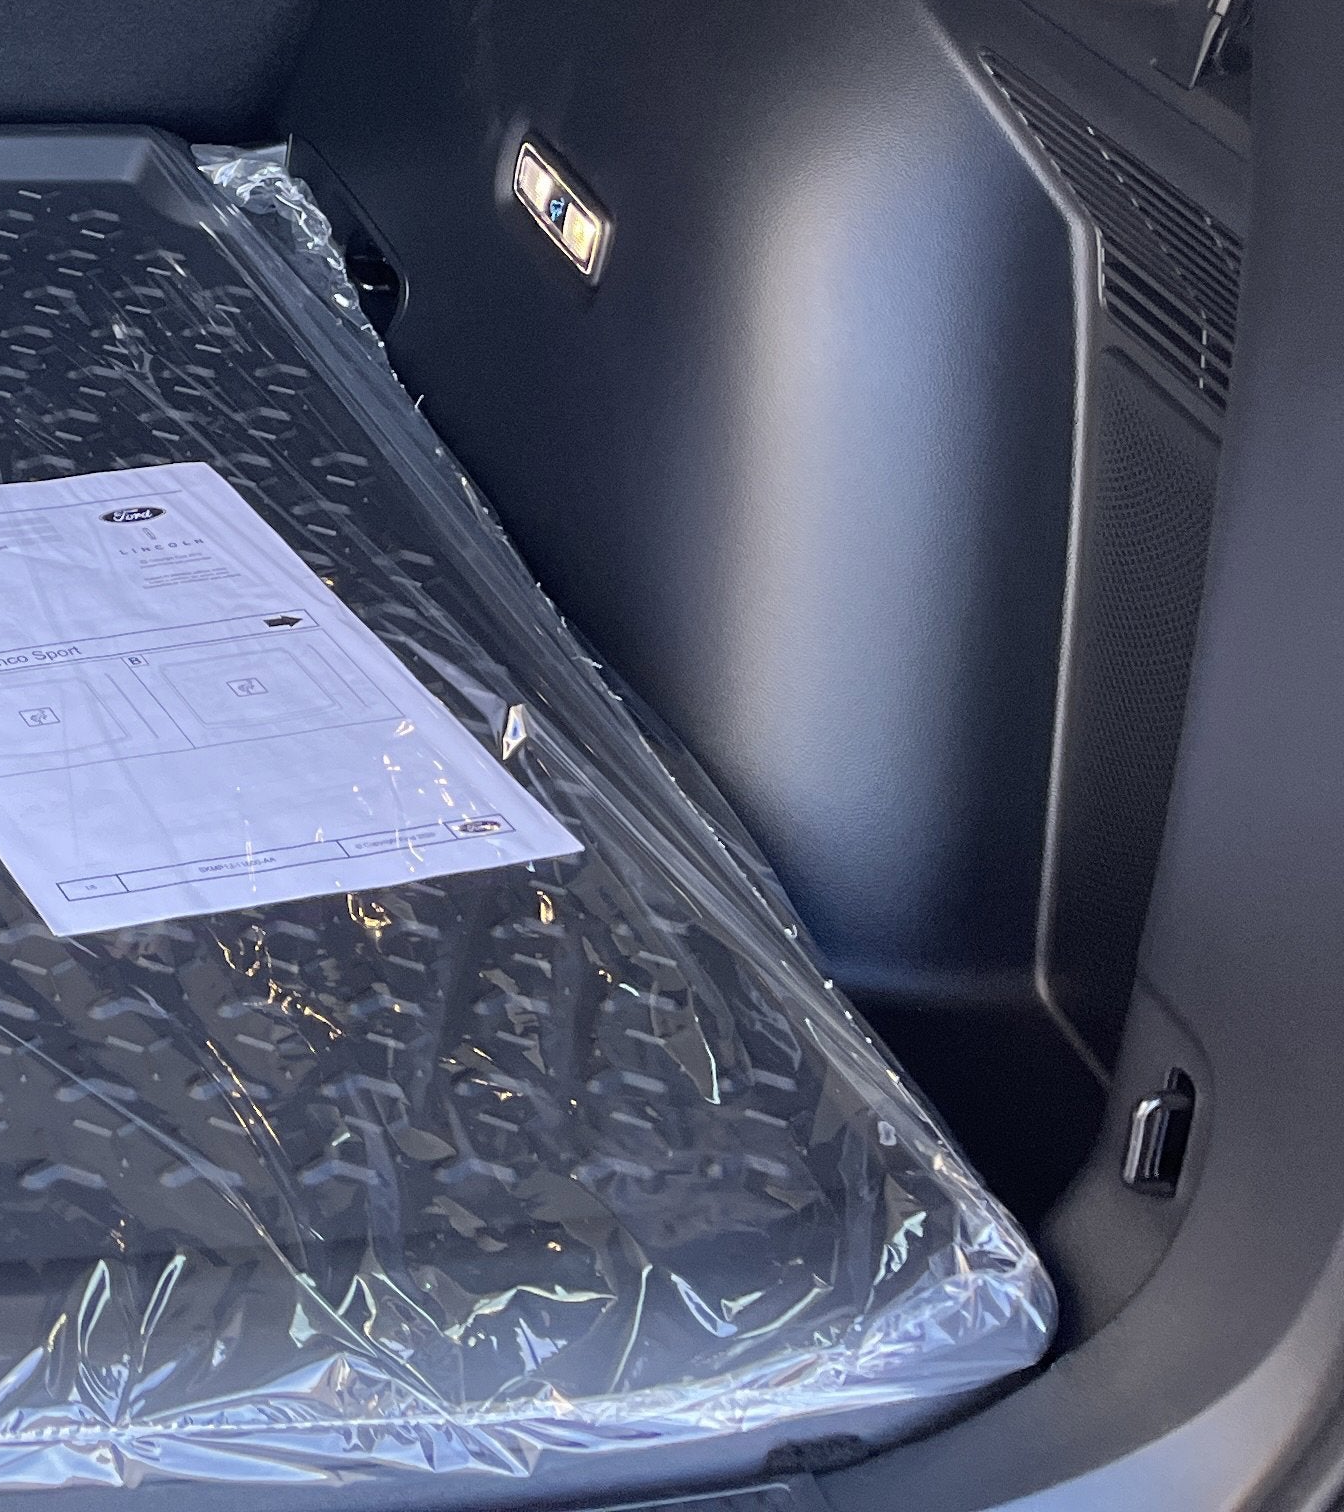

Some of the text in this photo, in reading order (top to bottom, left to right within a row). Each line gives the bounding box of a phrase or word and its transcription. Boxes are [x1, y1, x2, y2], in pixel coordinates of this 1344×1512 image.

[111, 508, 154, 523] Ford
[118, 538, 205, 555] LINCOLN
[31, 645, 83, 662] Sport
[128, 656, 142, 666] B
